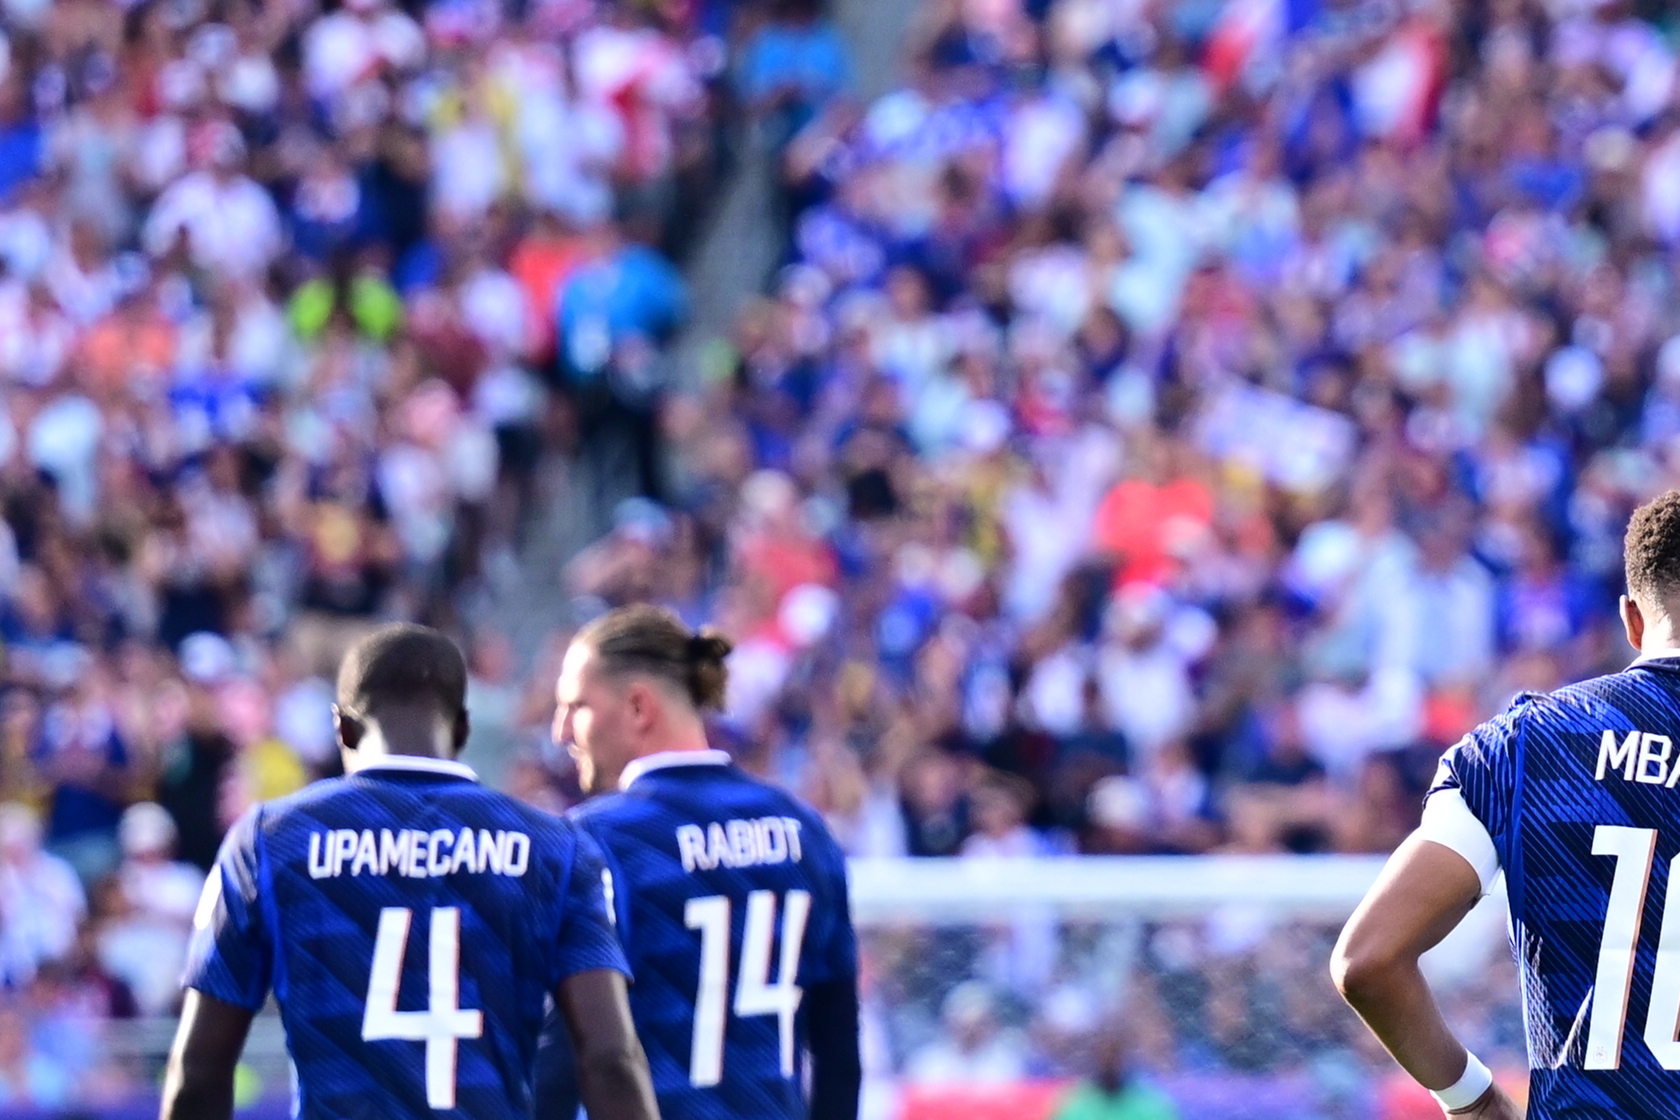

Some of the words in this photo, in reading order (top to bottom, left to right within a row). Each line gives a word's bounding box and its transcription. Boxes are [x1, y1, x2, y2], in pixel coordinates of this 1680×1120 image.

[307, 826, 531, 881] UPAMECANO
[676, 816, 803, 873] RABIOT
[361, 906, 483, 1110] 4
[684, 889, 812, 1087] 14
